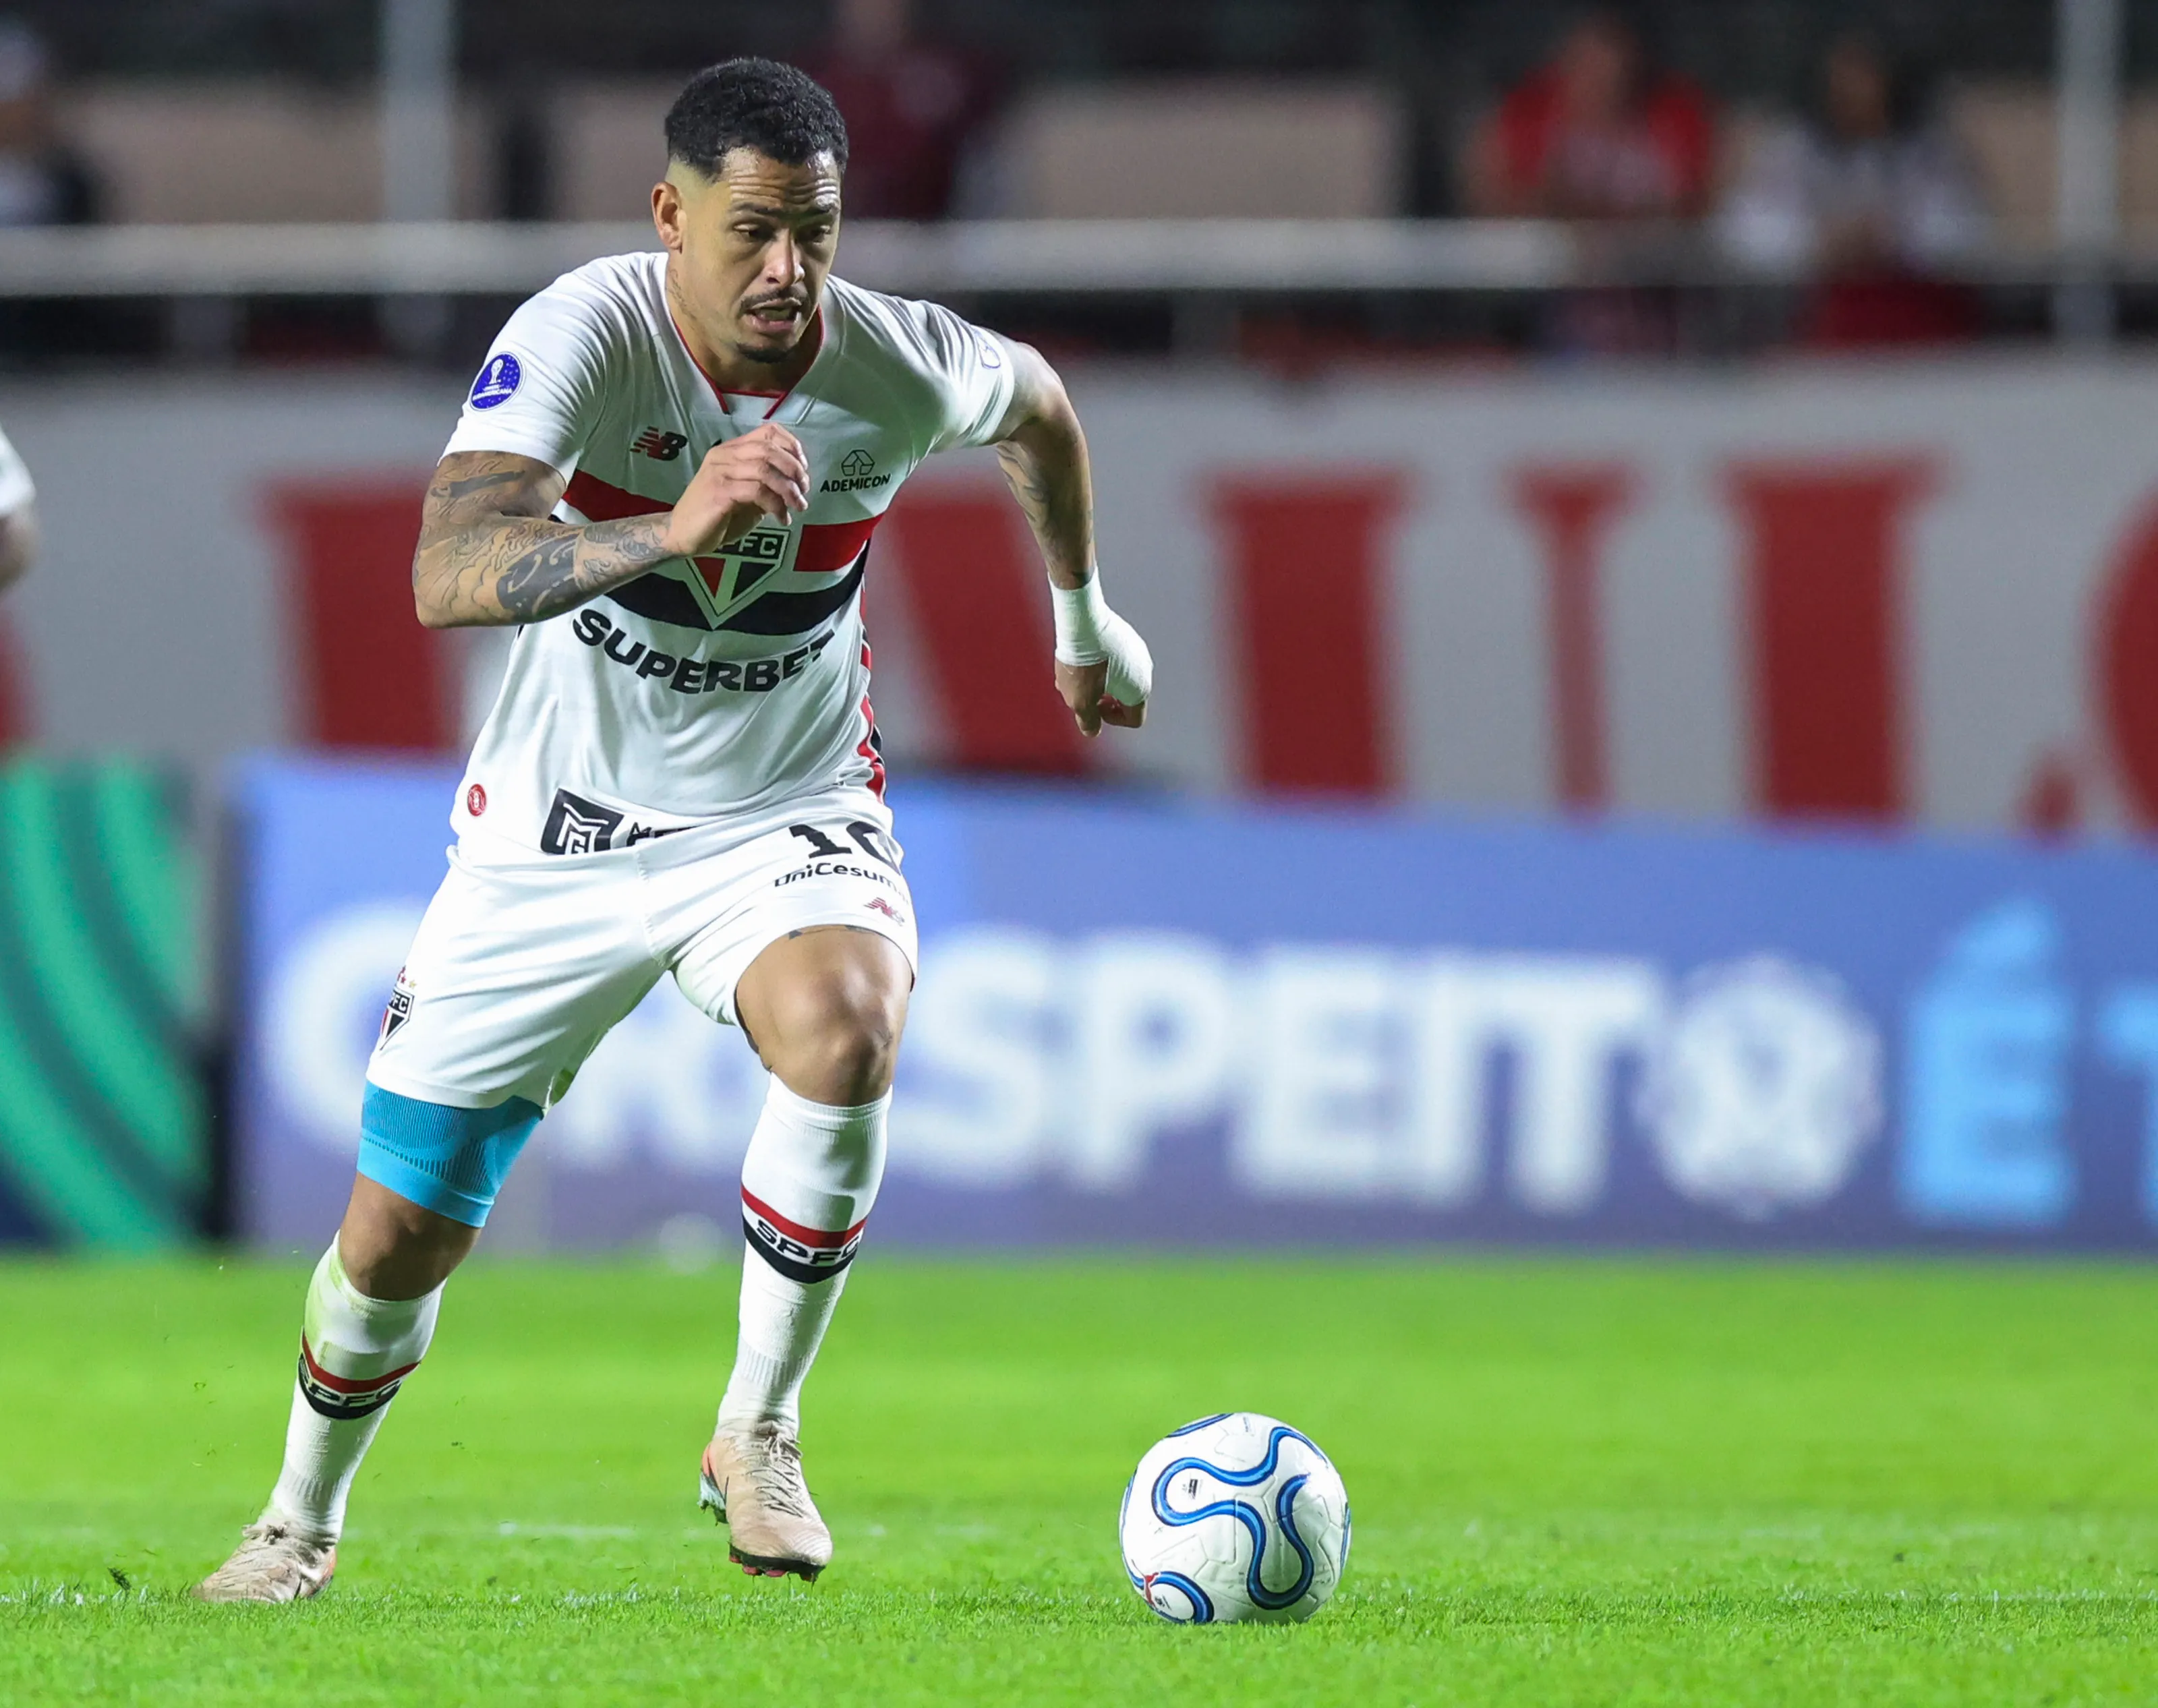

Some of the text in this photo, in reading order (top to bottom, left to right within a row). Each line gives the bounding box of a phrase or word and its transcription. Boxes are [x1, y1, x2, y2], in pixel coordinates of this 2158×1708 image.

[819, 473, 891, 493] ADEMICON
[717, 535, 778, 556] FC
[788, 820, 902, 877] 10
[774, 862, 908, 905] UniCesum
[389, 992, 409, 1012] FC
[756, 1218, 859, 1266] SPFC
